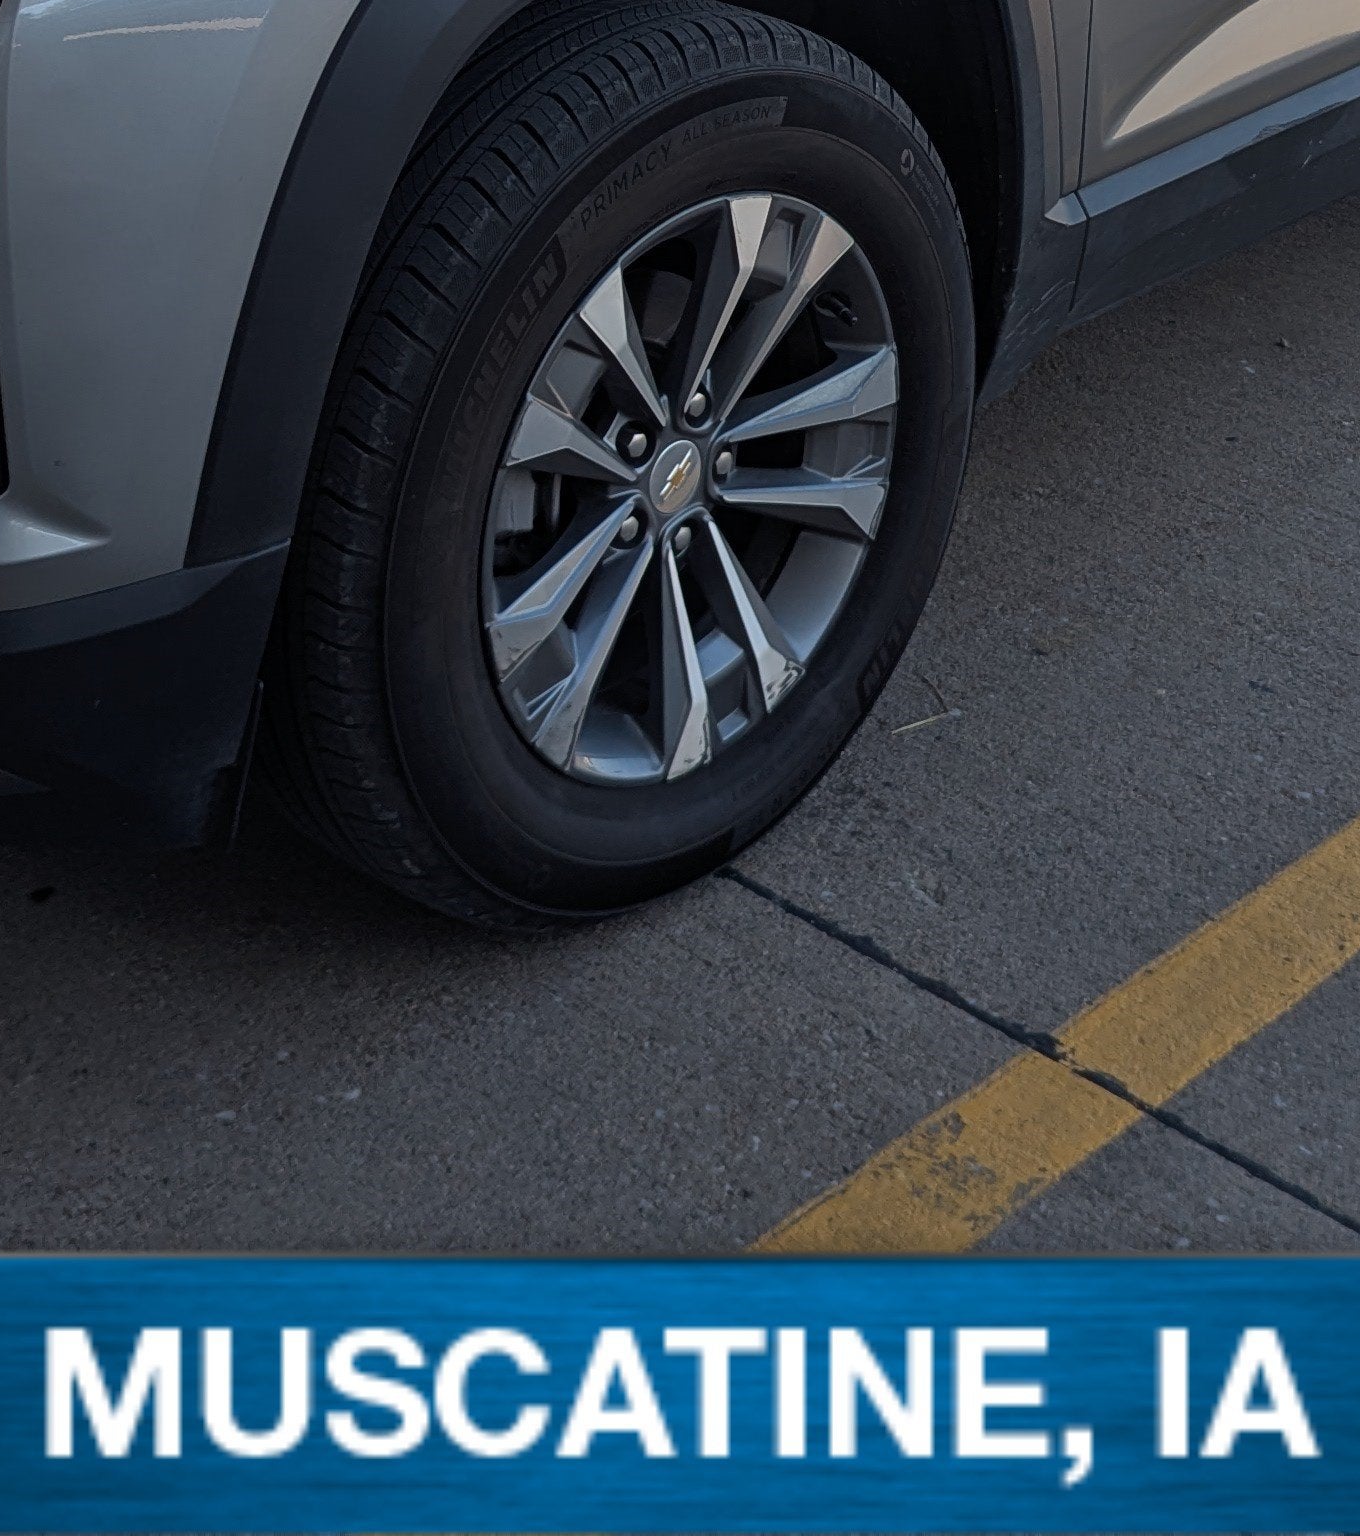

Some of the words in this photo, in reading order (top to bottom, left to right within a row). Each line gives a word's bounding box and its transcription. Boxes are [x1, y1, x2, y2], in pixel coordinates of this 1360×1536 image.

[579, 138, 673, 232] PRIMACY
[681, 127, 709, 144] ALL
[713, 106, 770, 128] SEASON
